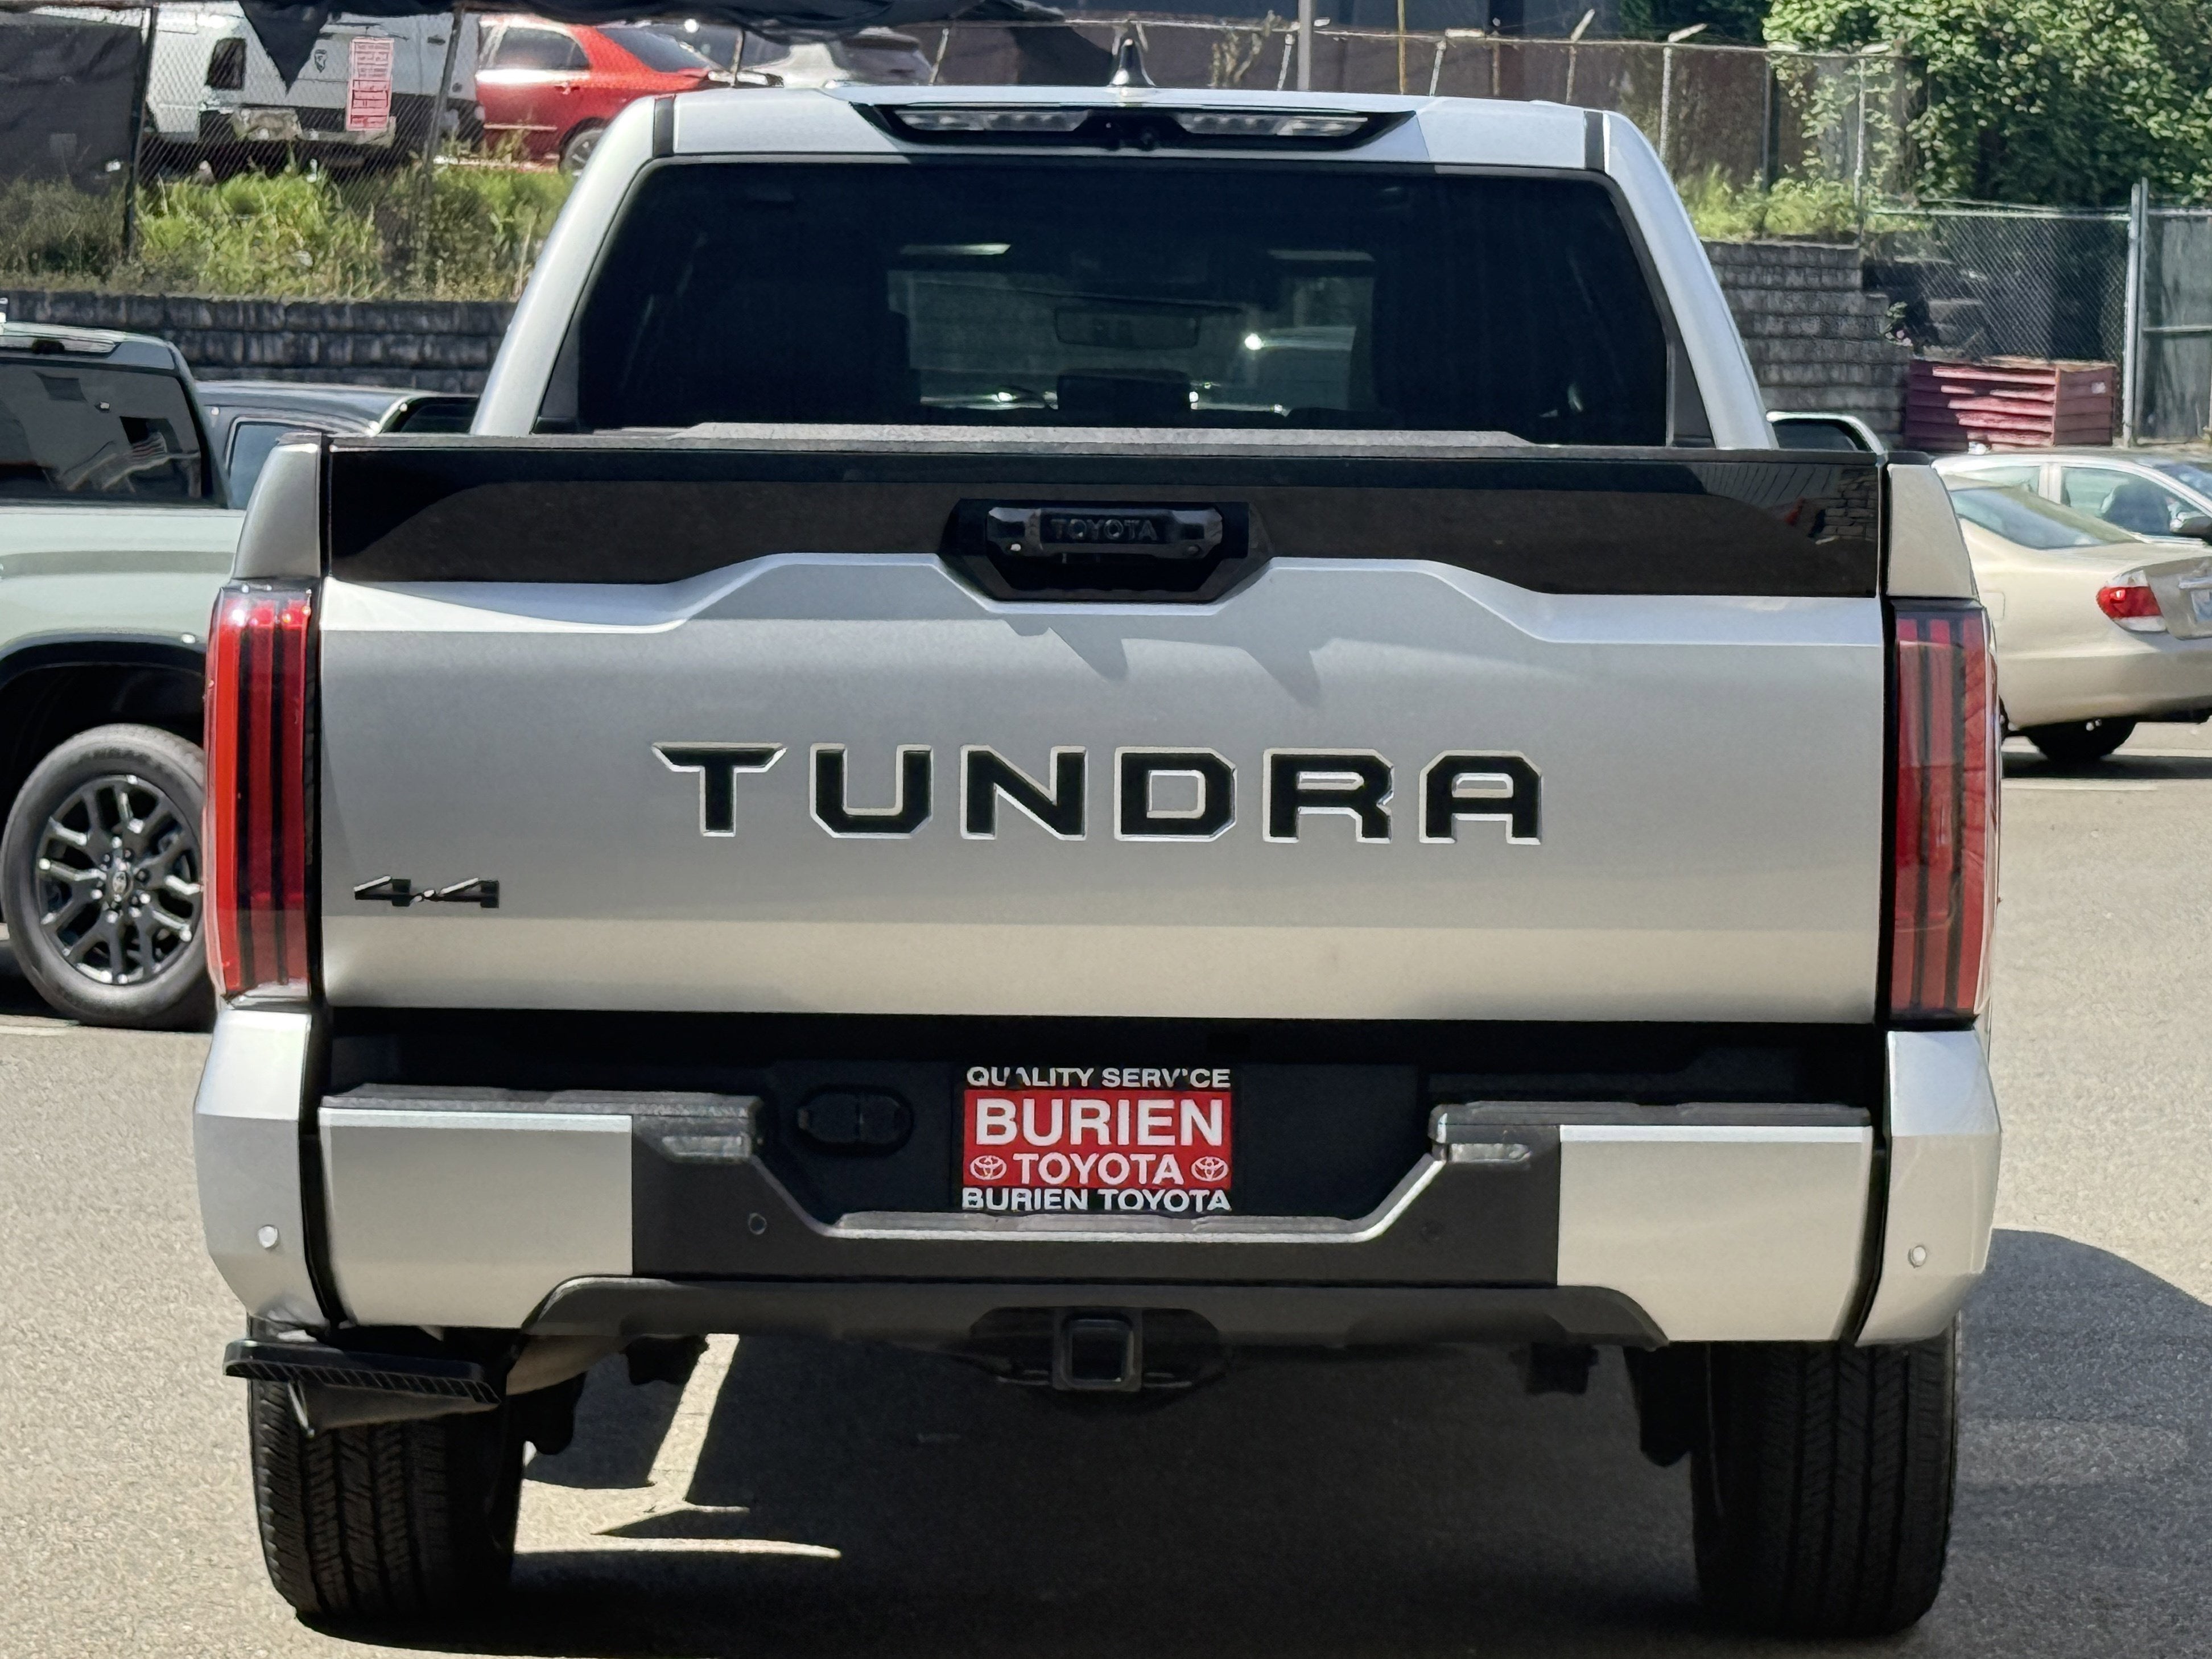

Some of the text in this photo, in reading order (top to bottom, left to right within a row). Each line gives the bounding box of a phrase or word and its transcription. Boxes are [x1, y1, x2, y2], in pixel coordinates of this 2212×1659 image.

[1051, 518, 1158, 541] TOYOTA
[650, 741, 1544, 846] TUNDRA
[976, 1098, 1223, 1146] BURIEN
[1013, 1152, 1185, 1185] TOYOTA
[962, 1187, 1232, 1212] BURIEN TOYOTA
